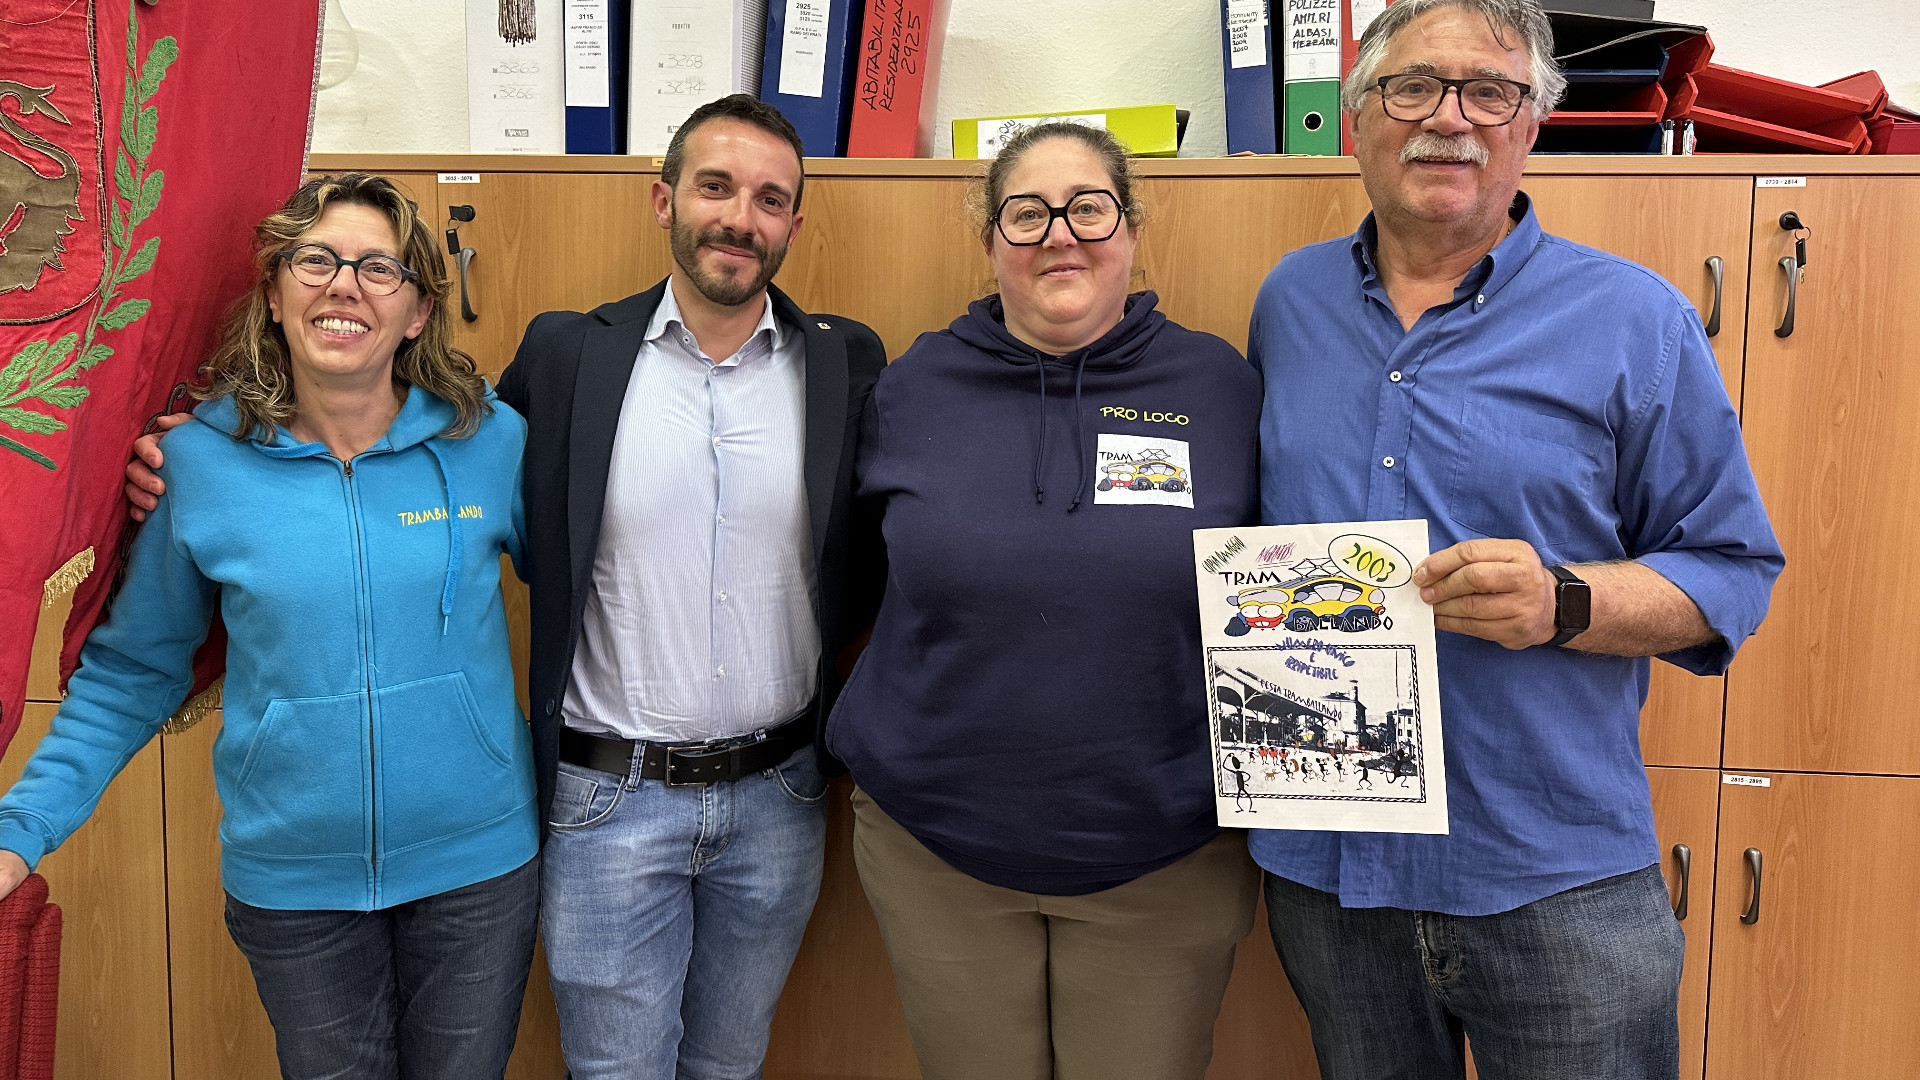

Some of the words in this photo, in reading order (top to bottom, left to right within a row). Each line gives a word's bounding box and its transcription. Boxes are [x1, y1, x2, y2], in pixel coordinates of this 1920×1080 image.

[1289, 0, 1336, 11] POLIZZE
[900, 10, 921, 75] 2925
[1292, 28, 1332, 40] ALBASI
[1292, 37, 1338, 49] MEZZADRI
[1099, 406, 1138, 421] PRO
[1143, 410, 1190, 426] LOCO
[1098, 450, 1134, 463] TRAM
[397, 505, 483, 527] TRAMBAANDO
[1341, 541, 1397, 583] 2003
[1218, 570, 1282, 587] TRAM
[1293, 615, 1394, 632] BALLANDO
[1260, 679, 1281, 695] FESTA
